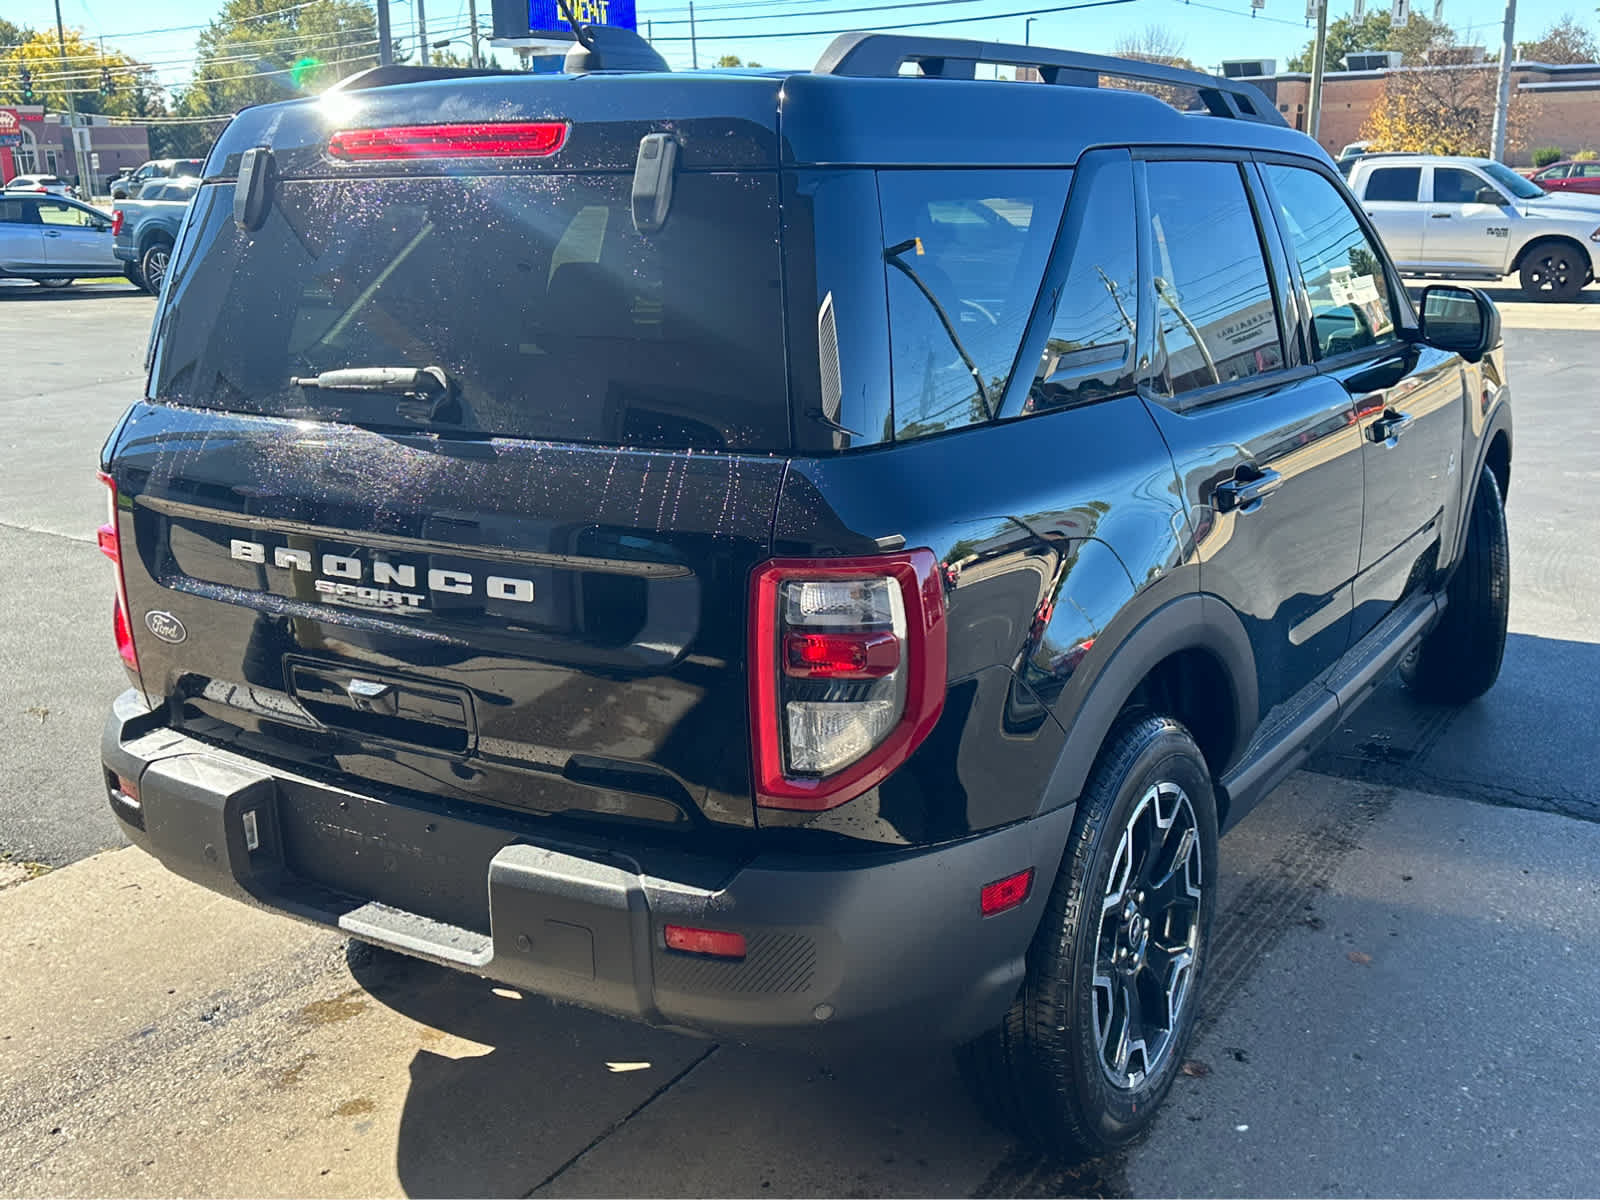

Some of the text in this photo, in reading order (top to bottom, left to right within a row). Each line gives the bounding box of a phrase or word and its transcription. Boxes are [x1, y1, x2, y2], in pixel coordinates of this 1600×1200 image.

[230, 539, 534, 602] BRONCO
[314, 579, 425, 606] SPORT
[152, 614, 178, 639] Ford
